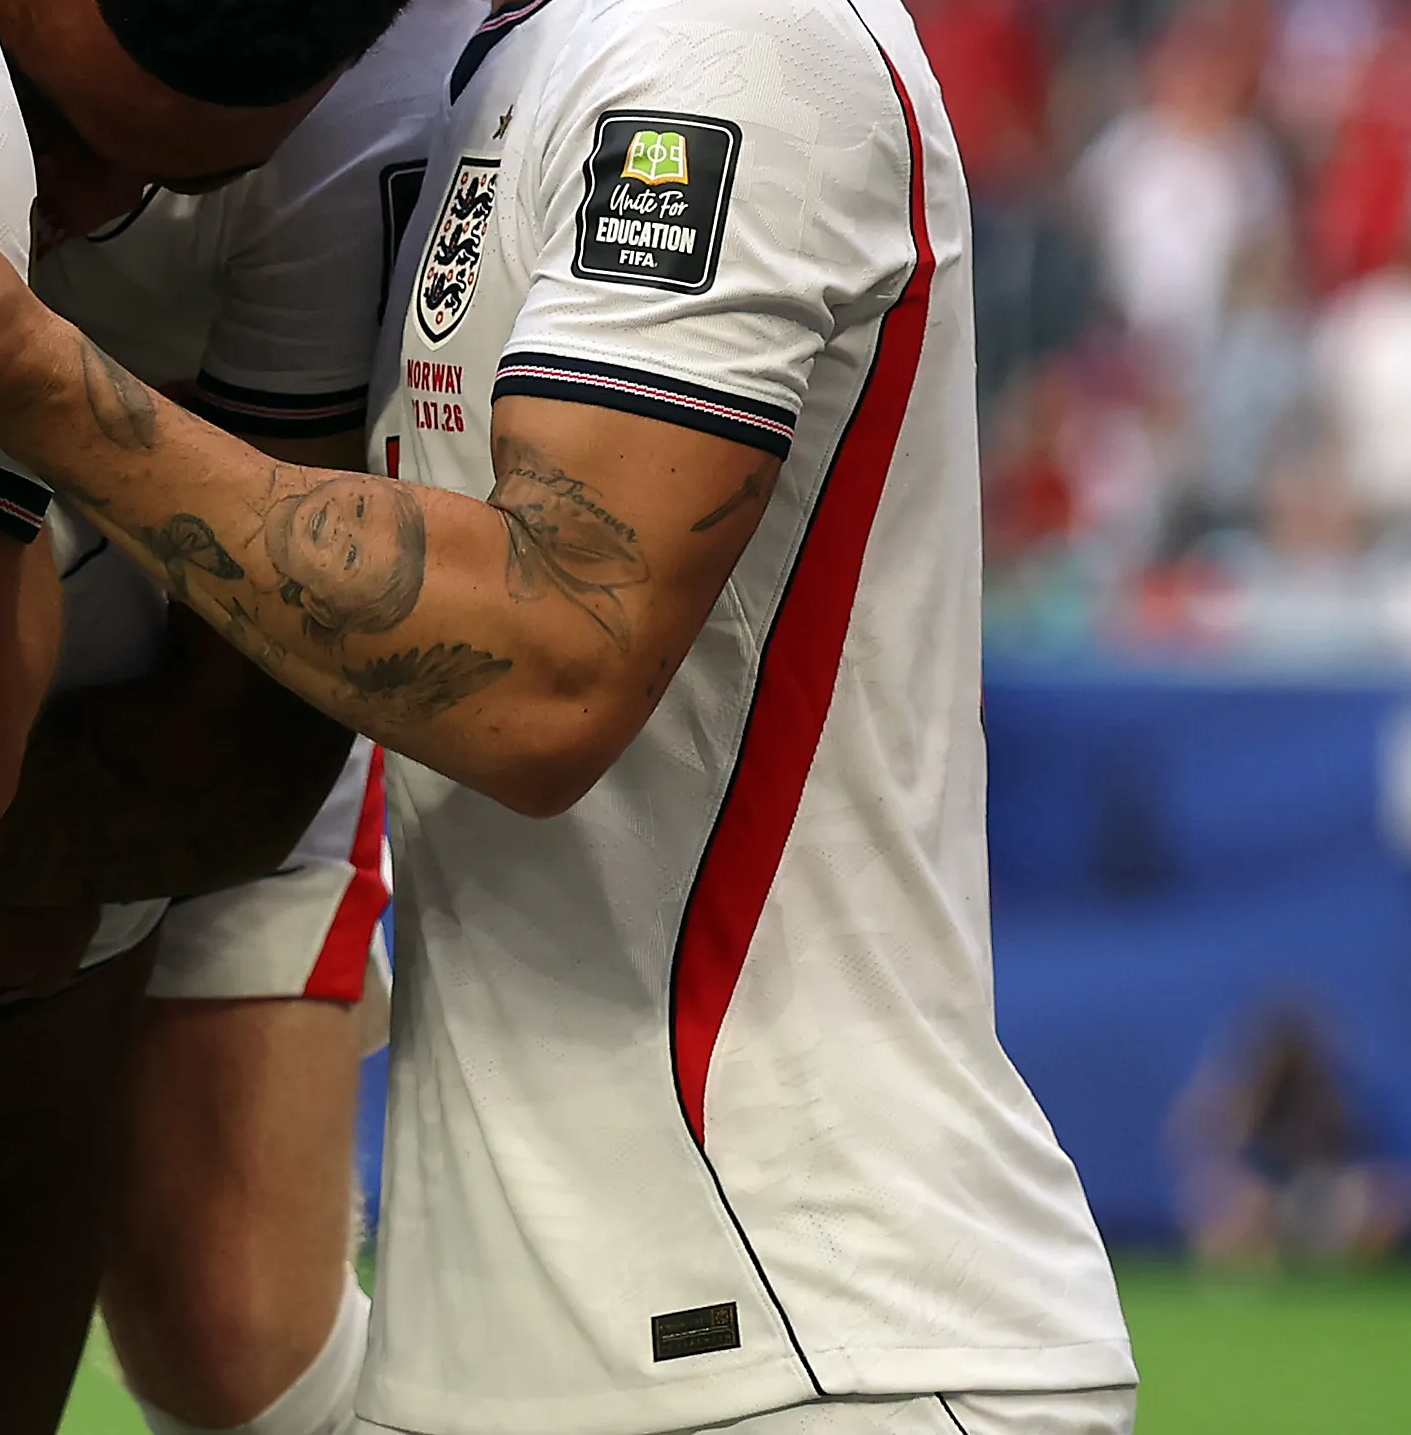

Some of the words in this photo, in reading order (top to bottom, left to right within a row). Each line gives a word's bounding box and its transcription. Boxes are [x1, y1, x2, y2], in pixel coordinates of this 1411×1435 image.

[610, 182, 658, 216] Unite
[658, 190, 689, 219] For
[595, 216, 697, 255] EDUCATION
[619, 249, 657, 268] FIFA
[407, 358, 463, 395] NORWAY
